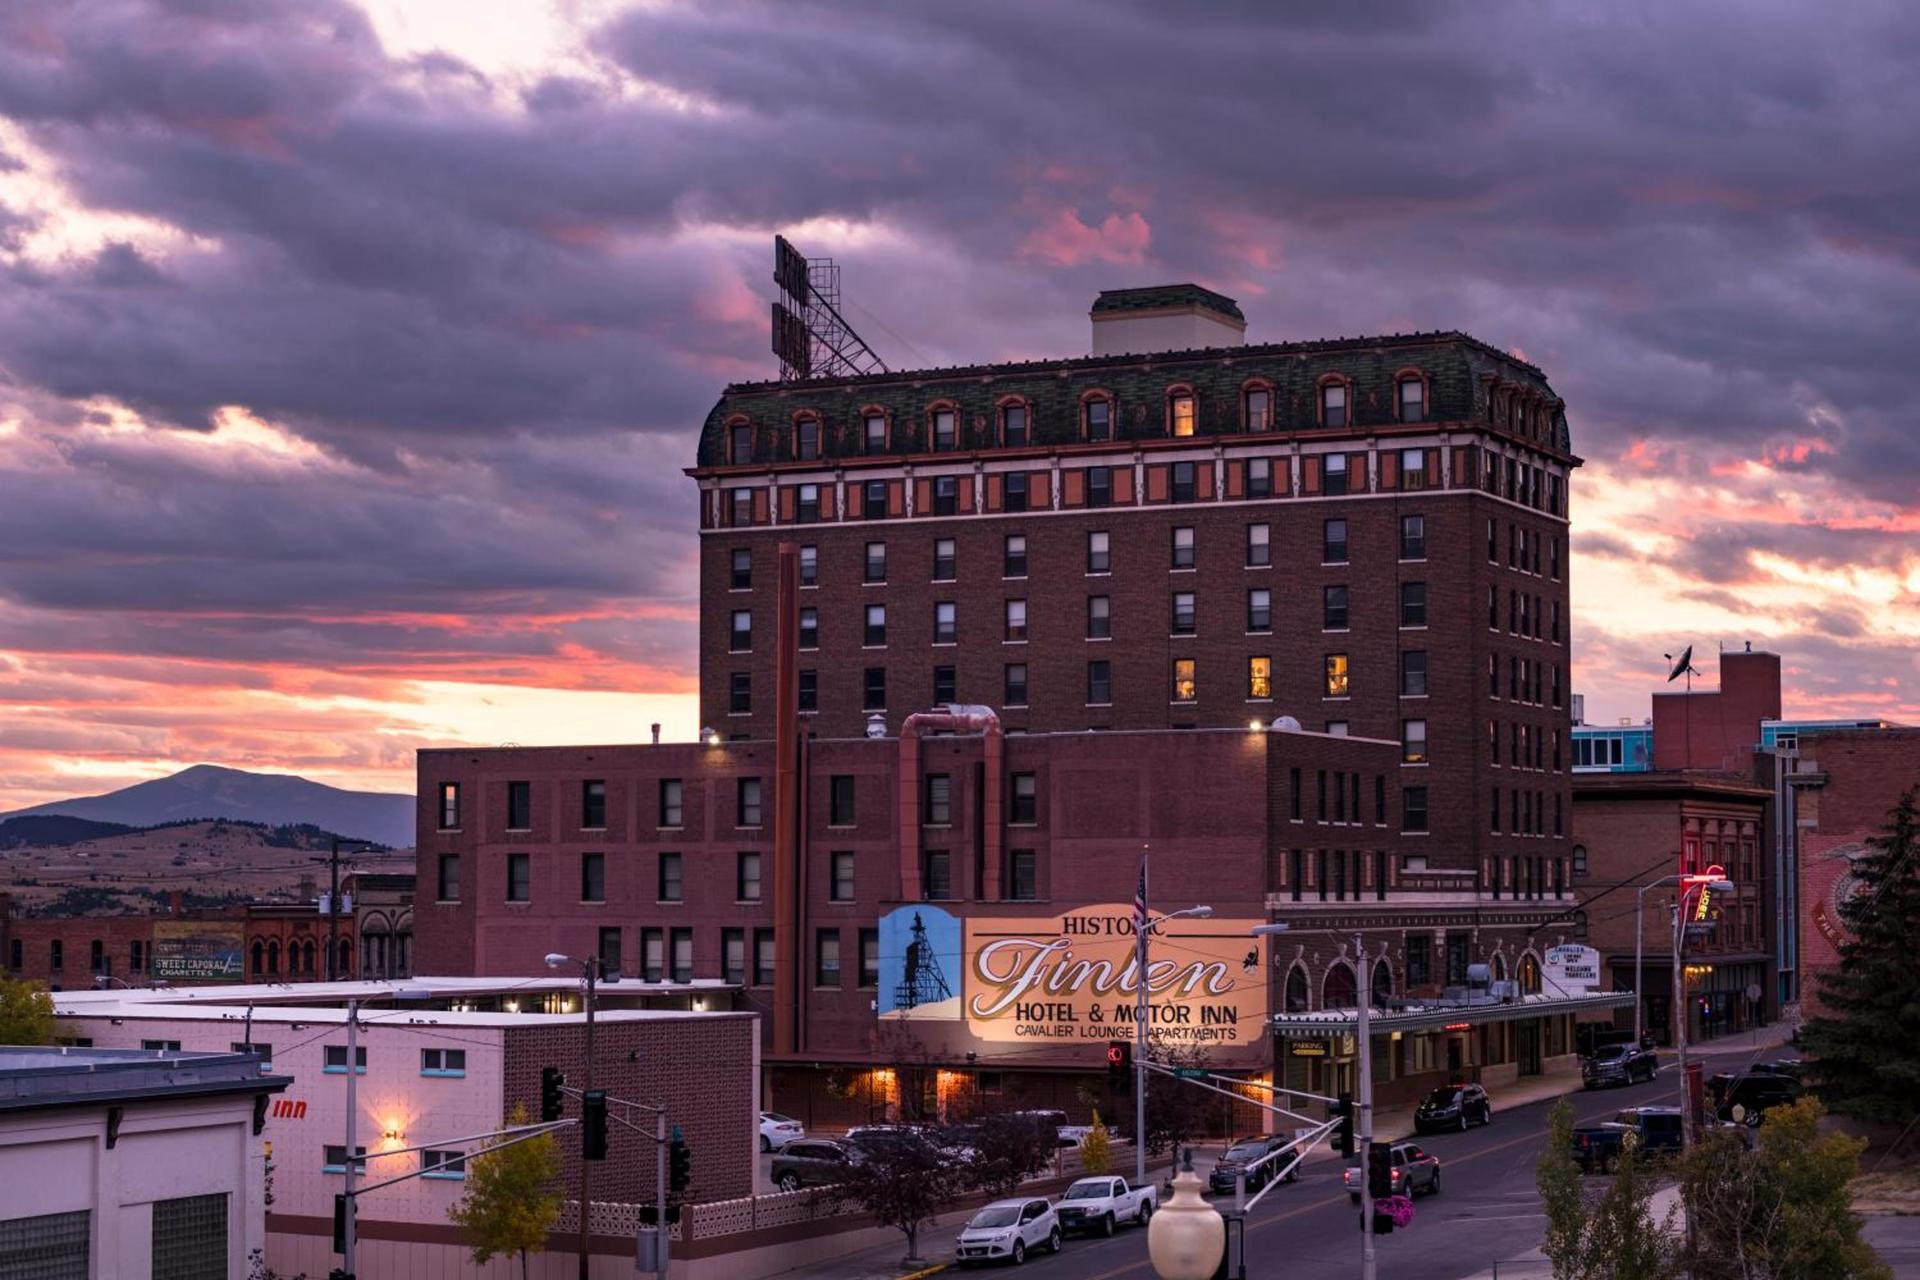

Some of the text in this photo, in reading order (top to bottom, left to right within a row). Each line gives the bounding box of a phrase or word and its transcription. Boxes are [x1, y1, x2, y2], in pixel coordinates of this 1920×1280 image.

[1063, 917, 1166, 936] HISTOIC
[1817, 913, 1836, 938] THE
[155, 959, 186, 969] SWEET
[187, 959, 225, 970] CAPORAL
[160, 969, 213, 977] CIGARETTES
[1016, 1003, 1079, 1021] HOTEL
[1089, 1003, 1104, 1022] &
[1201, 1005, 1238, 1025] INN
[1015, 1025, 1237, 1040] CAVALIER LOUNGE APARTMENTS
